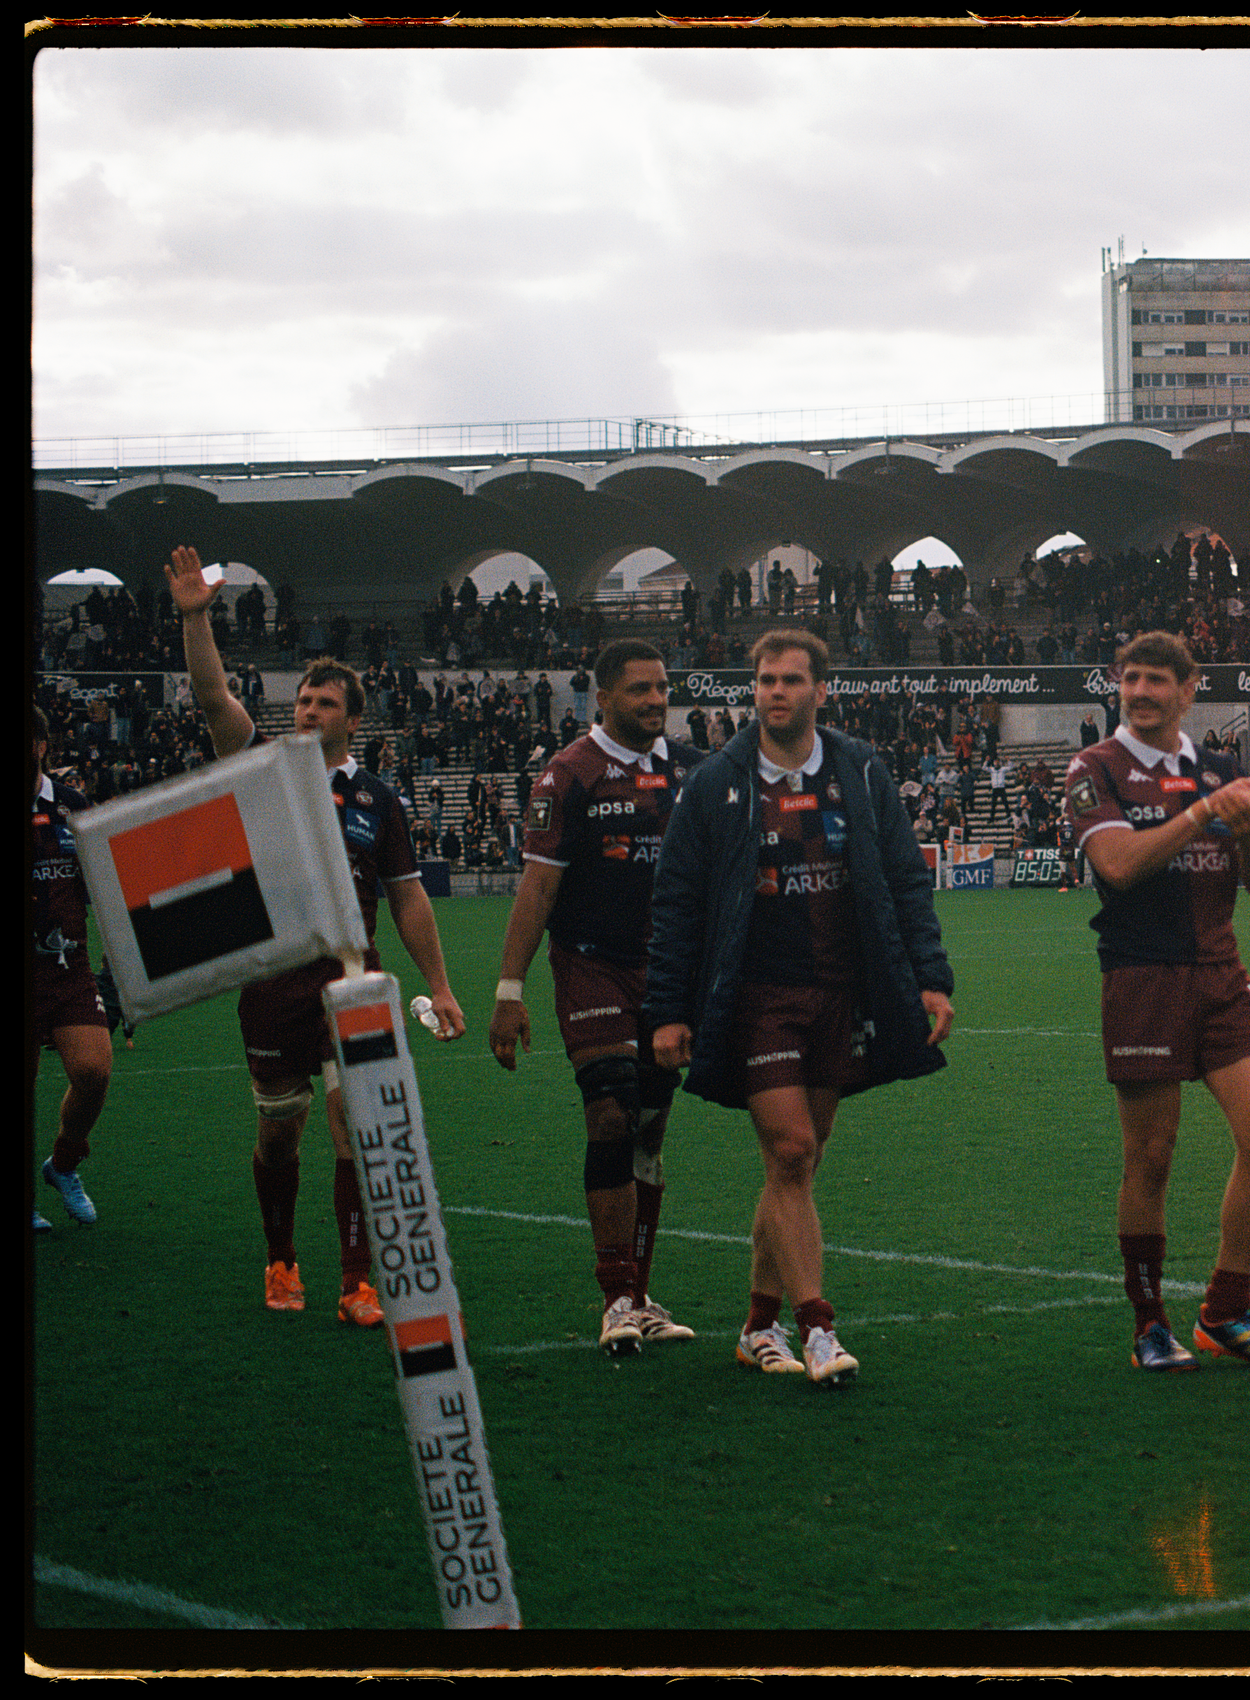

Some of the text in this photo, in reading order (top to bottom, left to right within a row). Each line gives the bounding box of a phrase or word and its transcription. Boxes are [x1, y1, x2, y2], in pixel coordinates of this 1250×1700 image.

[347, 824, 375, 841] HUMAN
[588, 801, 635, 820] epsa
[784, 799, 814, 809] Betclic
[952, 869, 991, 886] GMF
[357, 1123, 411, 1300] SOCIETE
[380, 1080, 441, 1294] GENERALE
[418, 1436, 472, 1610] SOCIETE
[440, 1391, 502, 1604] GENERALE
